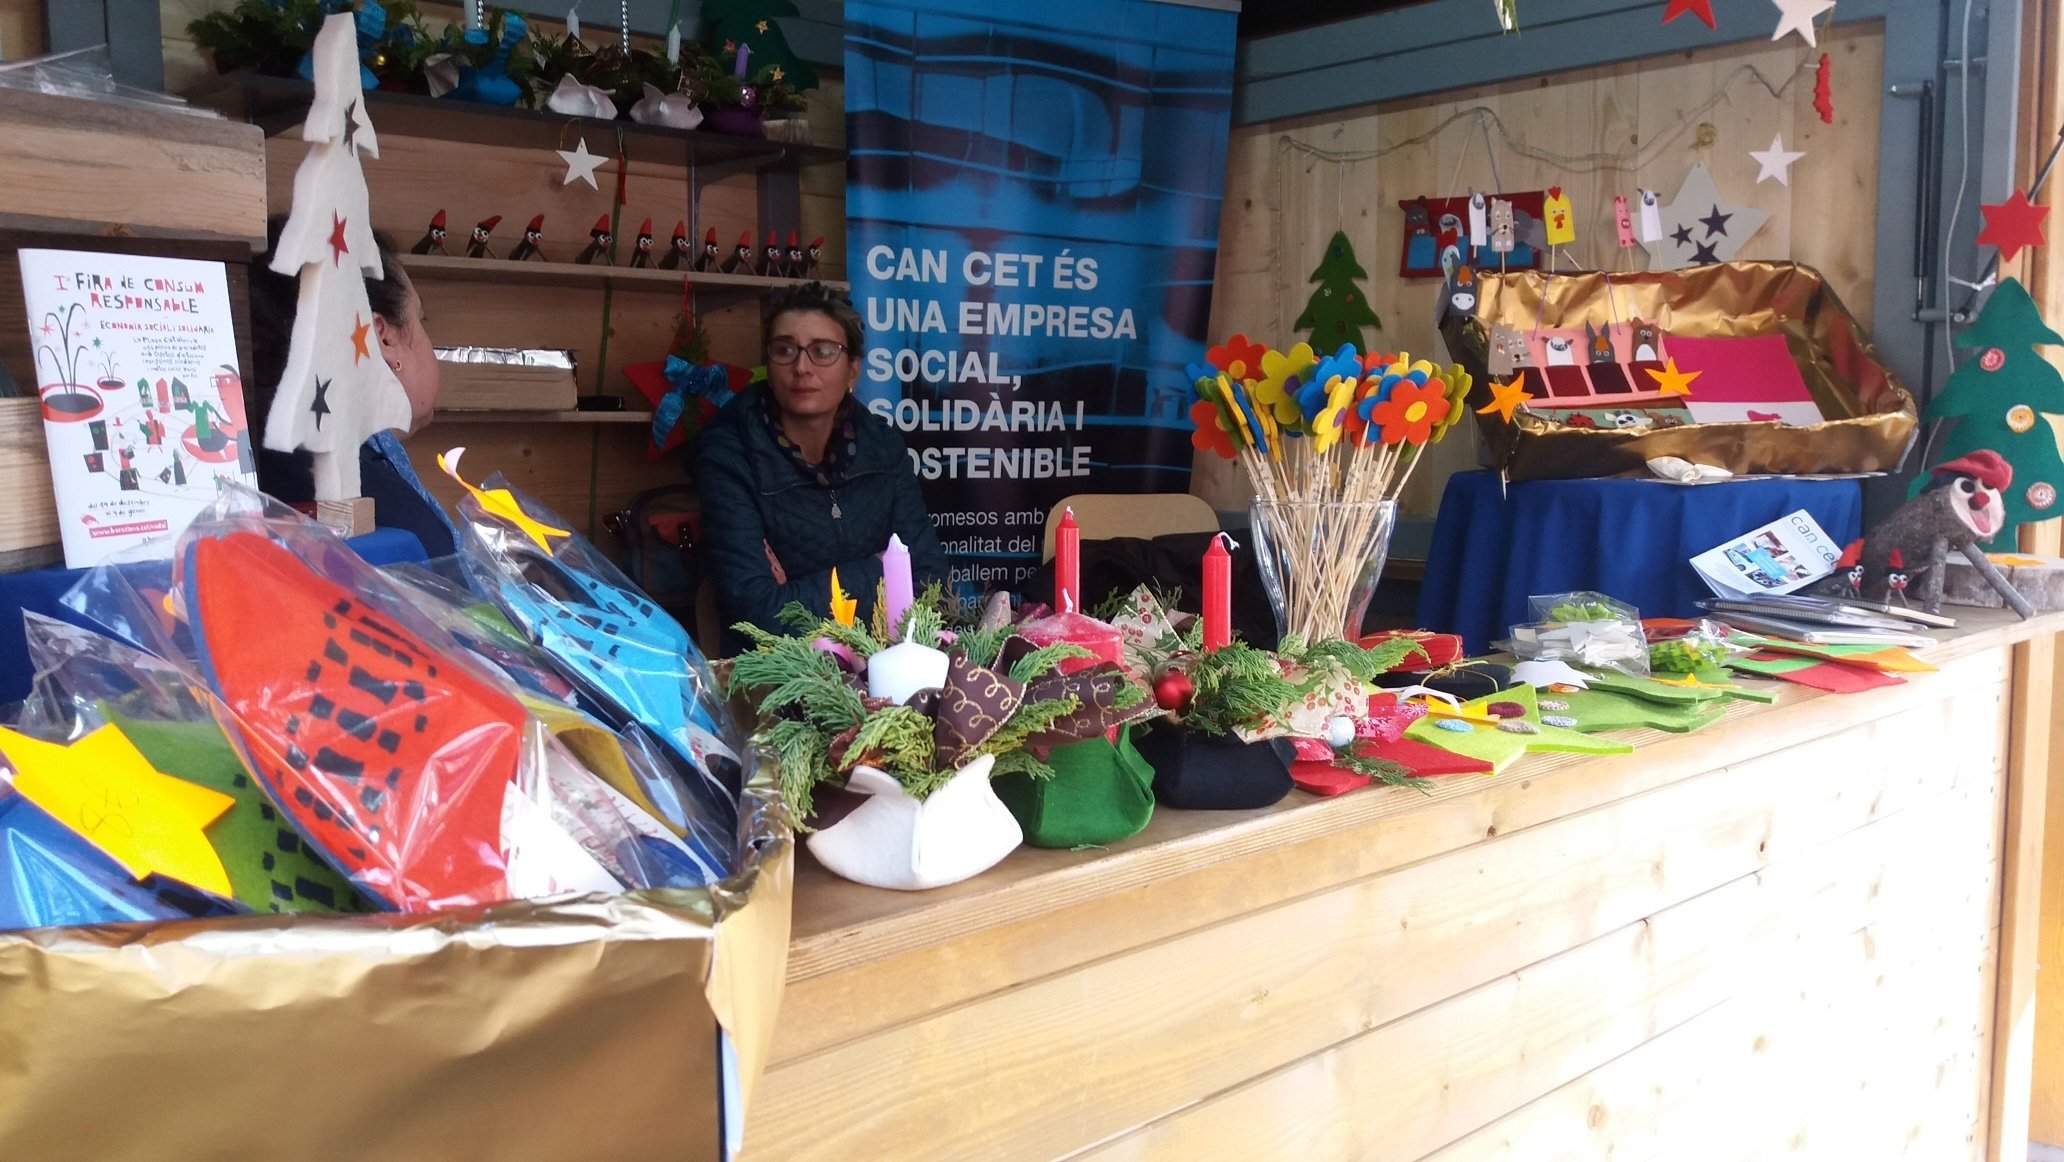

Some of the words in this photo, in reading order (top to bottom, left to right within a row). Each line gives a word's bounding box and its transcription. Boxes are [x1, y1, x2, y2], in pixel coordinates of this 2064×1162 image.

[866, 244, 948, 284] CAN
[962, 250, 1043, 288] CET
[1053, 249, 1099, 291] ÉS
[867, 297, 947, 333] UNA
[959, 301, 1137, 340] EMPRESA
[867, 347, 1022, 391] SOCIAL,
[867, 392, 1065, 432] SOLIDÀRIA
[1075, 400, 1085, 431] I
[928, 511, 998, 527] omesos
[1004, 507, 1045, 525] amb
[1791, 515, 1818, 544] can
[1008, 535, 1035, 553] del
[951, 563, 1008, 583] ballem
